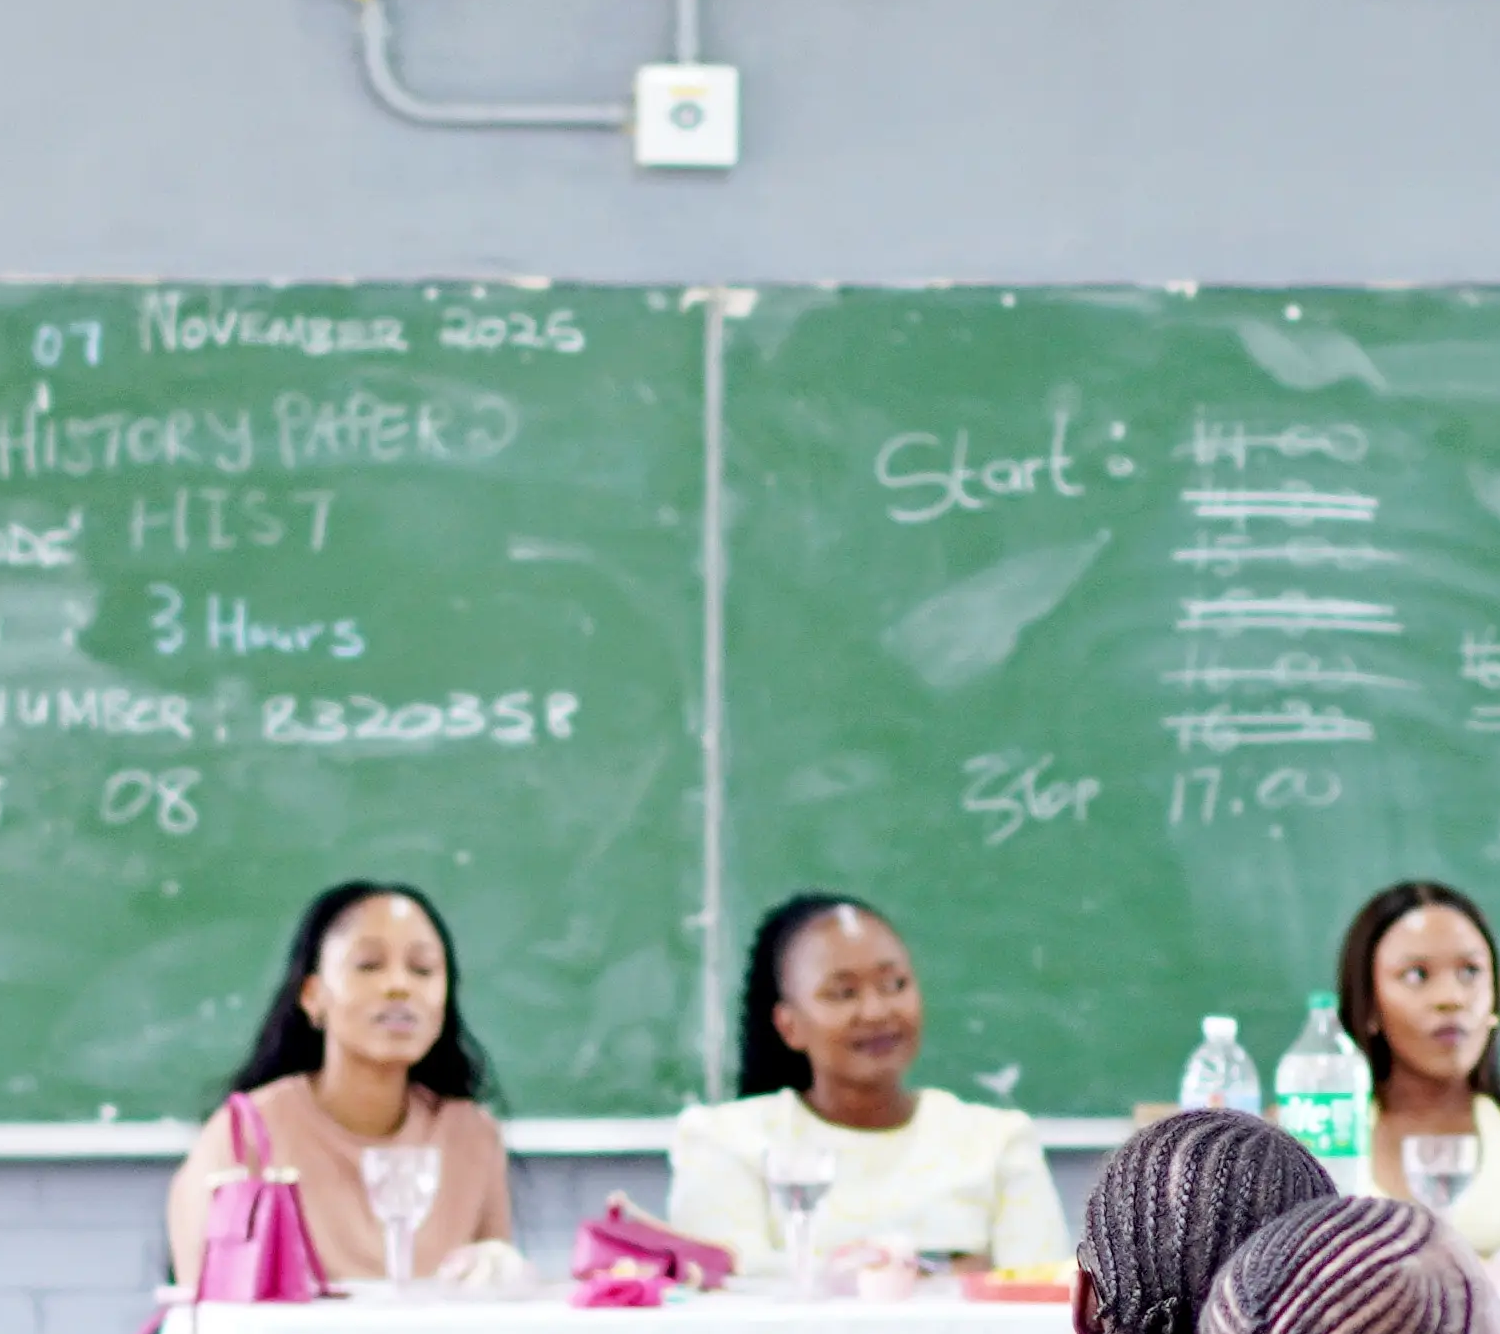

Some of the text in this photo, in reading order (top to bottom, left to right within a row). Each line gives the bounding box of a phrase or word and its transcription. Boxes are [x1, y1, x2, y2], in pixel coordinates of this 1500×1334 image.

[32, 320, 102, 367] 07
[138, 289, 408, 356] NOVEMBER
[438, 308, 586, 353] 2025
[274, 391, 451, 469] PAPER
[130, 486, 334, 553] HIST
[145, 584, 186, 654] 3
[103, 770, 200, 834] 08
